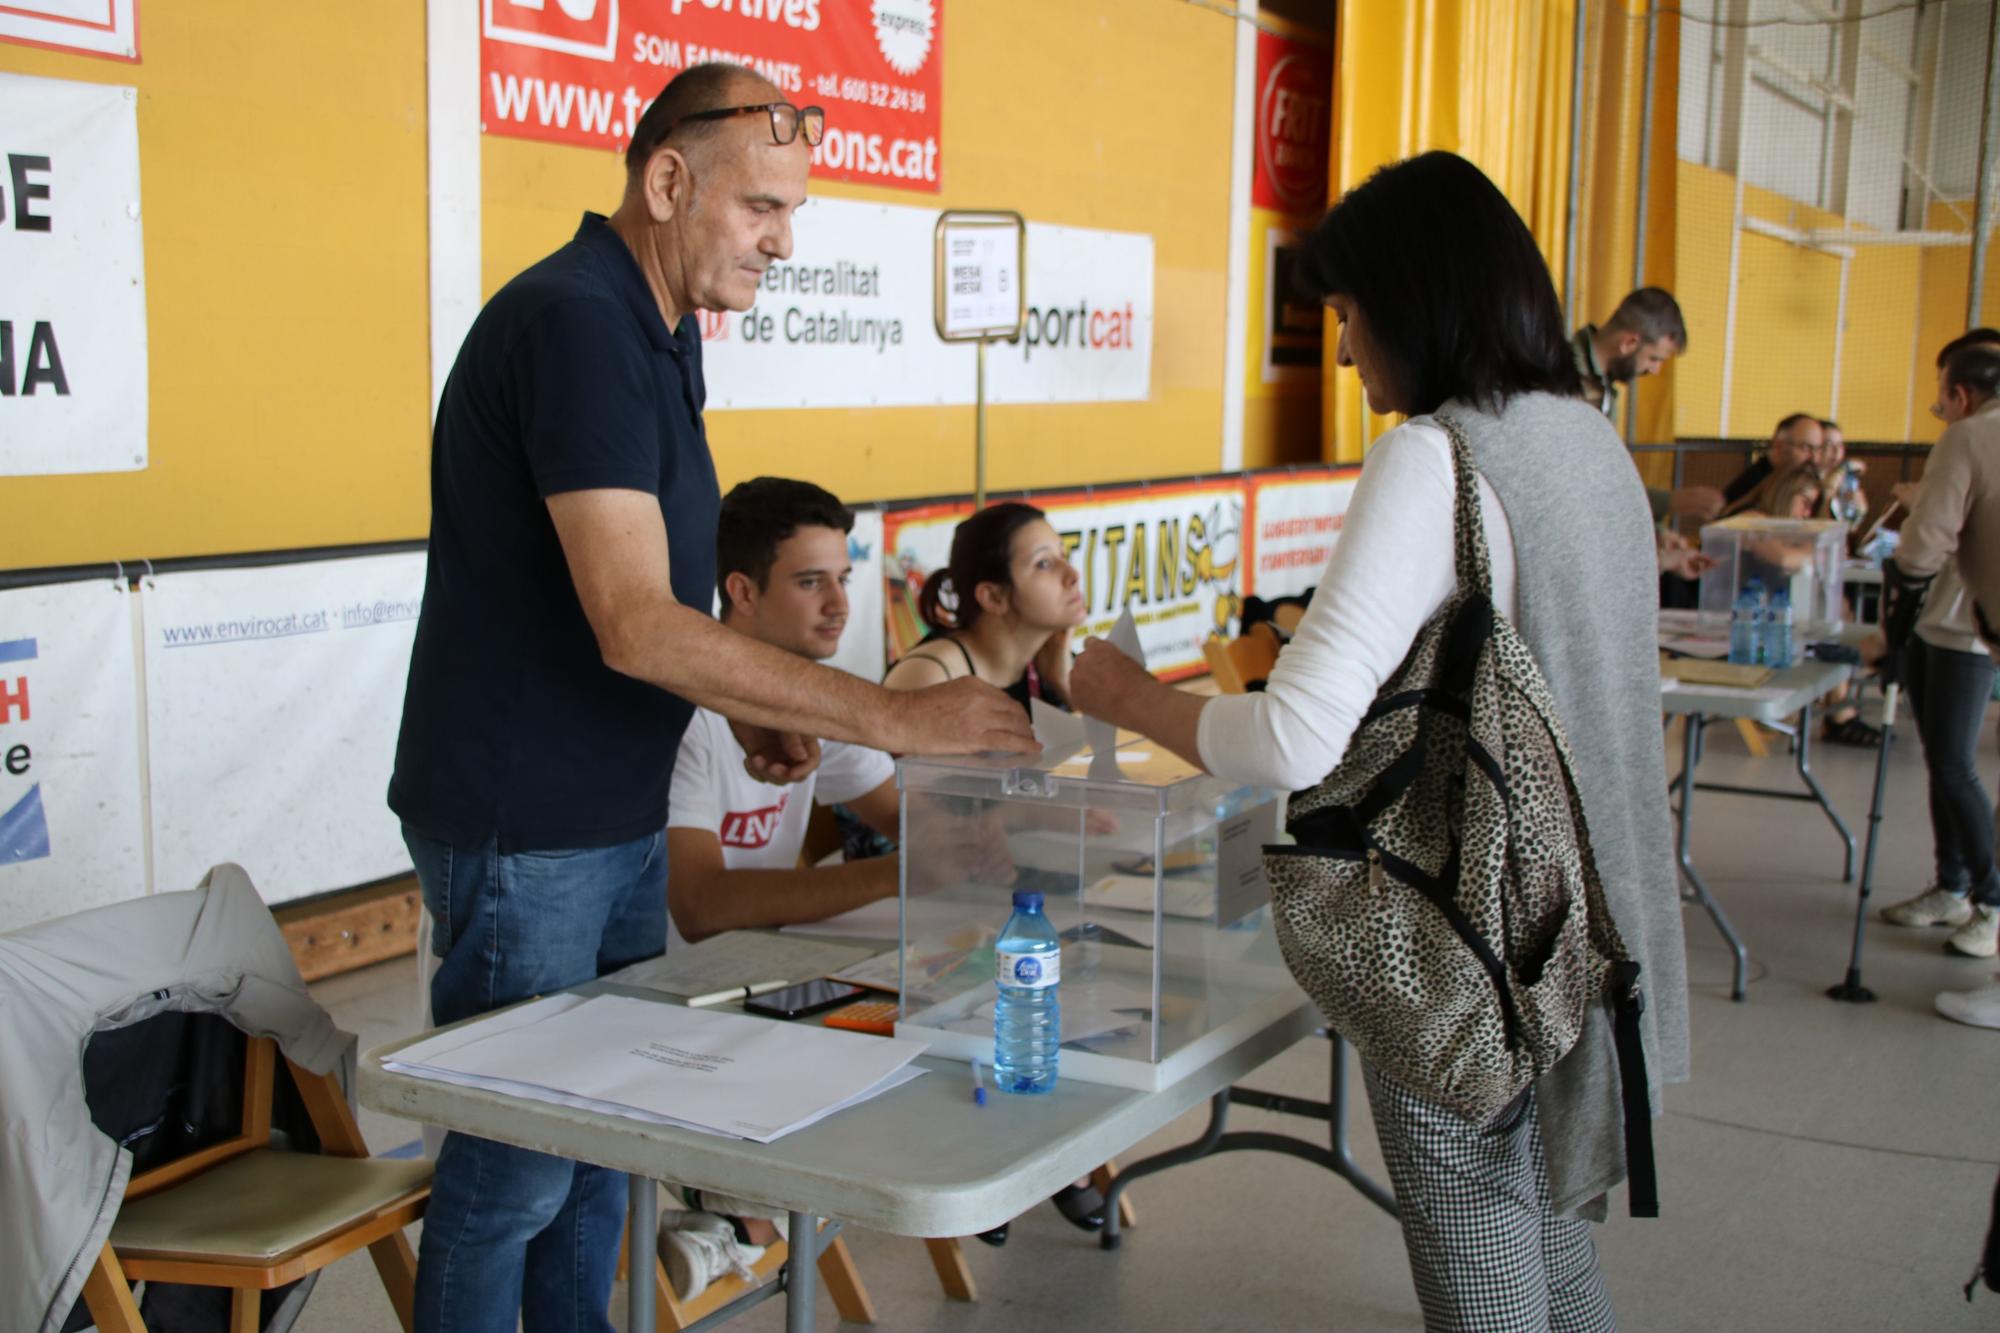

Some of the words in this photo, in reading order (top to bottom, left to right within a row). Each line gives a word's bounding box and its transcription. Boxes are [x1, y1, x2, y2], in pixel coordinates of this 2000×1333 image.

[633, 32, 683, 69] SOM
[757, 260, 880, 297] eneralitat
[741, 306, 776, 342] de
[785, 307, 904, 354] Catalunya
[163, 609, 328, 643] www.envirocat.cat
